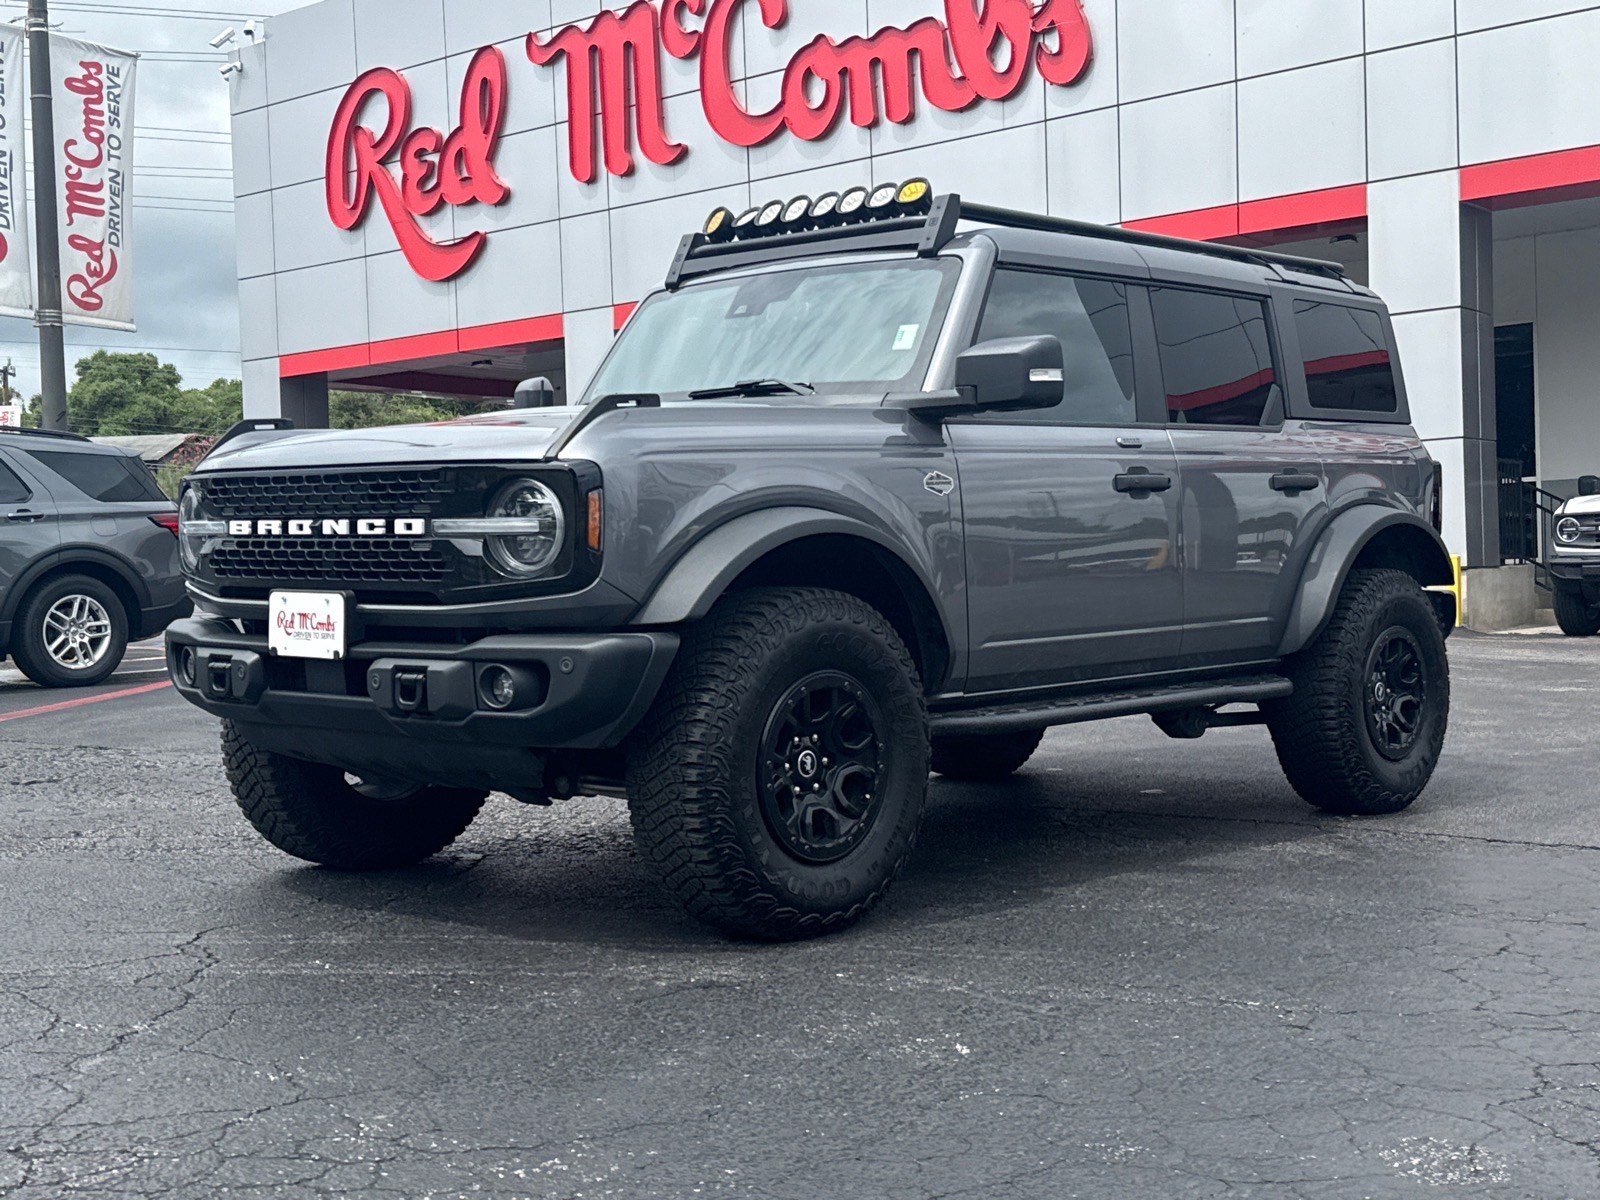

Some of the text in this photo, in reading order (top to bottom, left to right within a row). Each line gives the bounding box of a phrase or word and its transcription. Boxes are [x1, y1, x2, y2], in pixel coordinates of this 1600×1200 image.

[63, 60, 118, 311] Red McCombs
[106, 63, 122, 248] DRIVEN TO SERVE
[326, 0, 1093, 281] Red McCombs
[228, 518, 425, 536] BRONCO
[277, 610, 337, 636] Red McCombs
